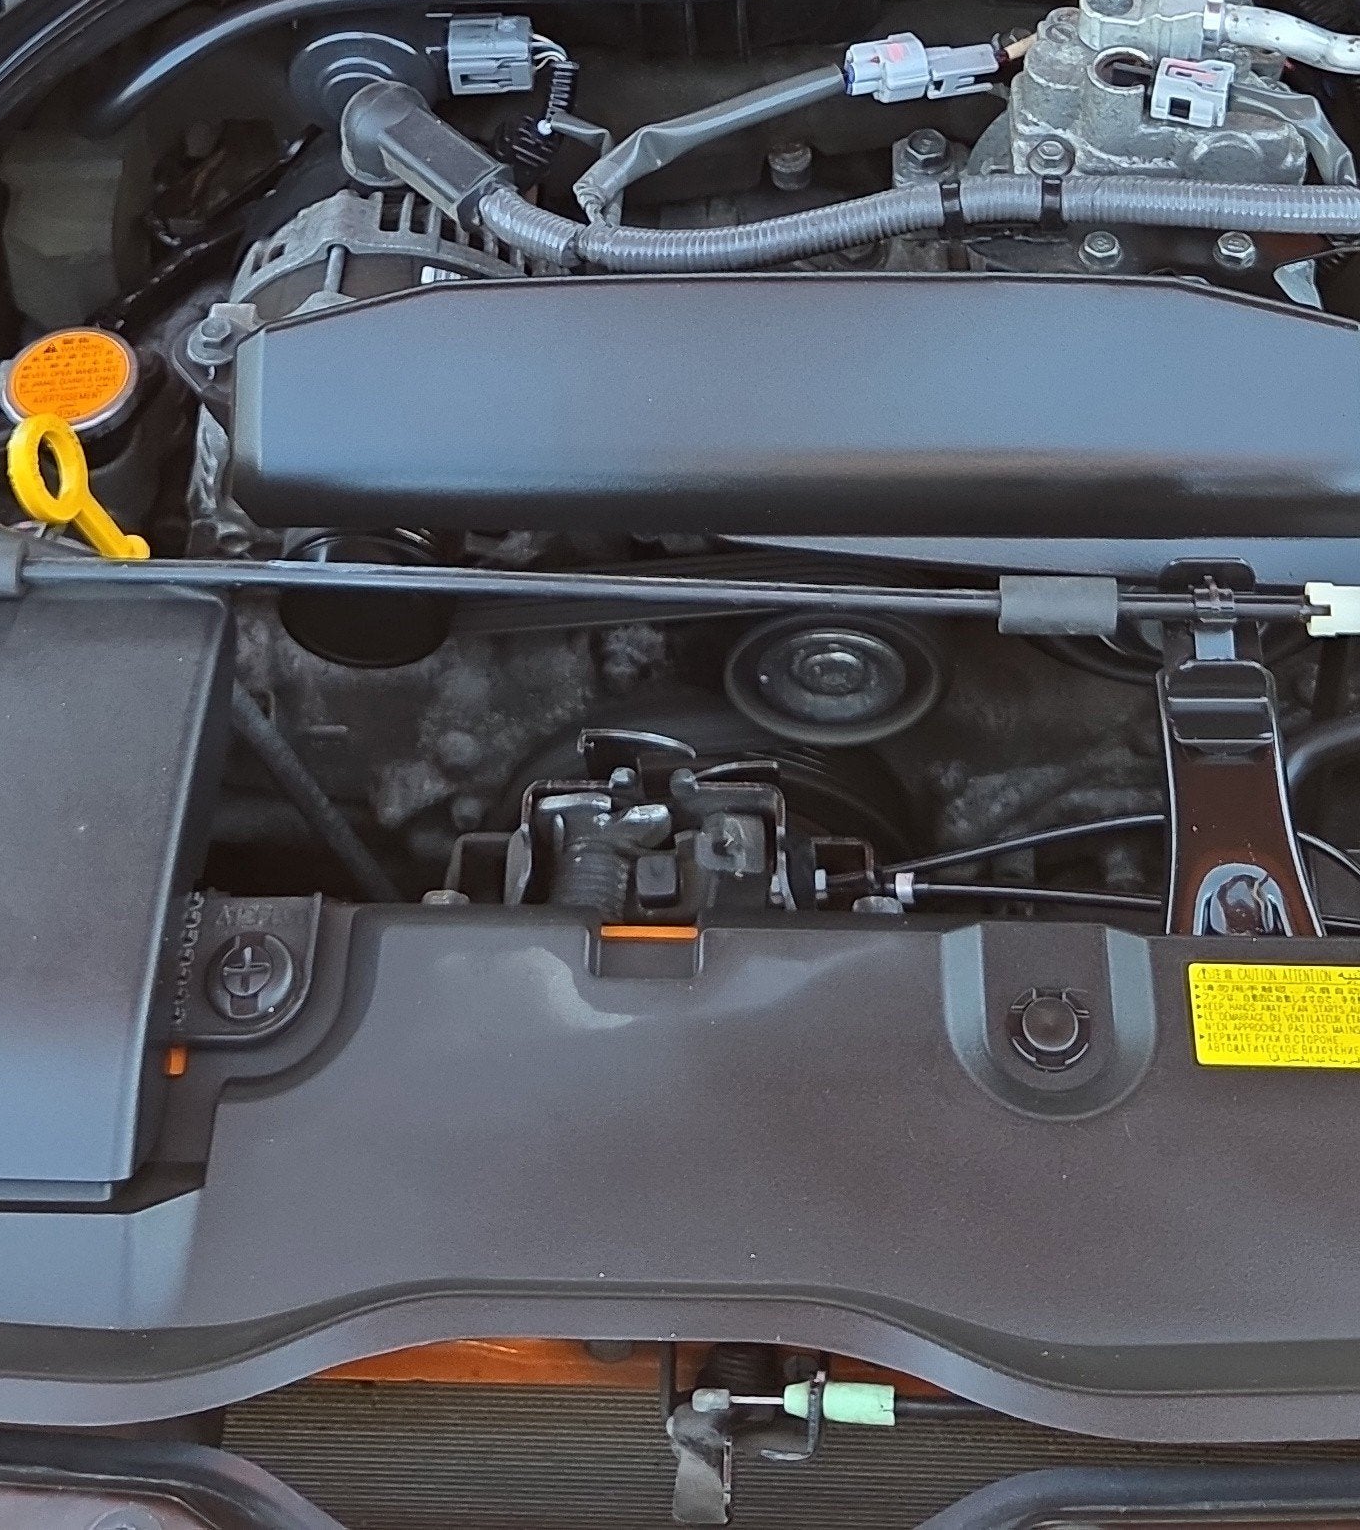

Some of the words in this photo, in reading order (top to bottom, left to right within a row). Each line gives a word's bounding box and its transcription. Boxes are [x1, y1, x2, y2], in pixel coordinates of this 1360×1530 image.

[1237, 968, 1277, 981] CAUTION
[1283, 969, 1332, 981] ATTENTION
[1314, 1005, 1344, 1015] STARTS
[1287, 1024, 1306, 1032] PAS
[1310, 1024, 1328, 1033] LES
